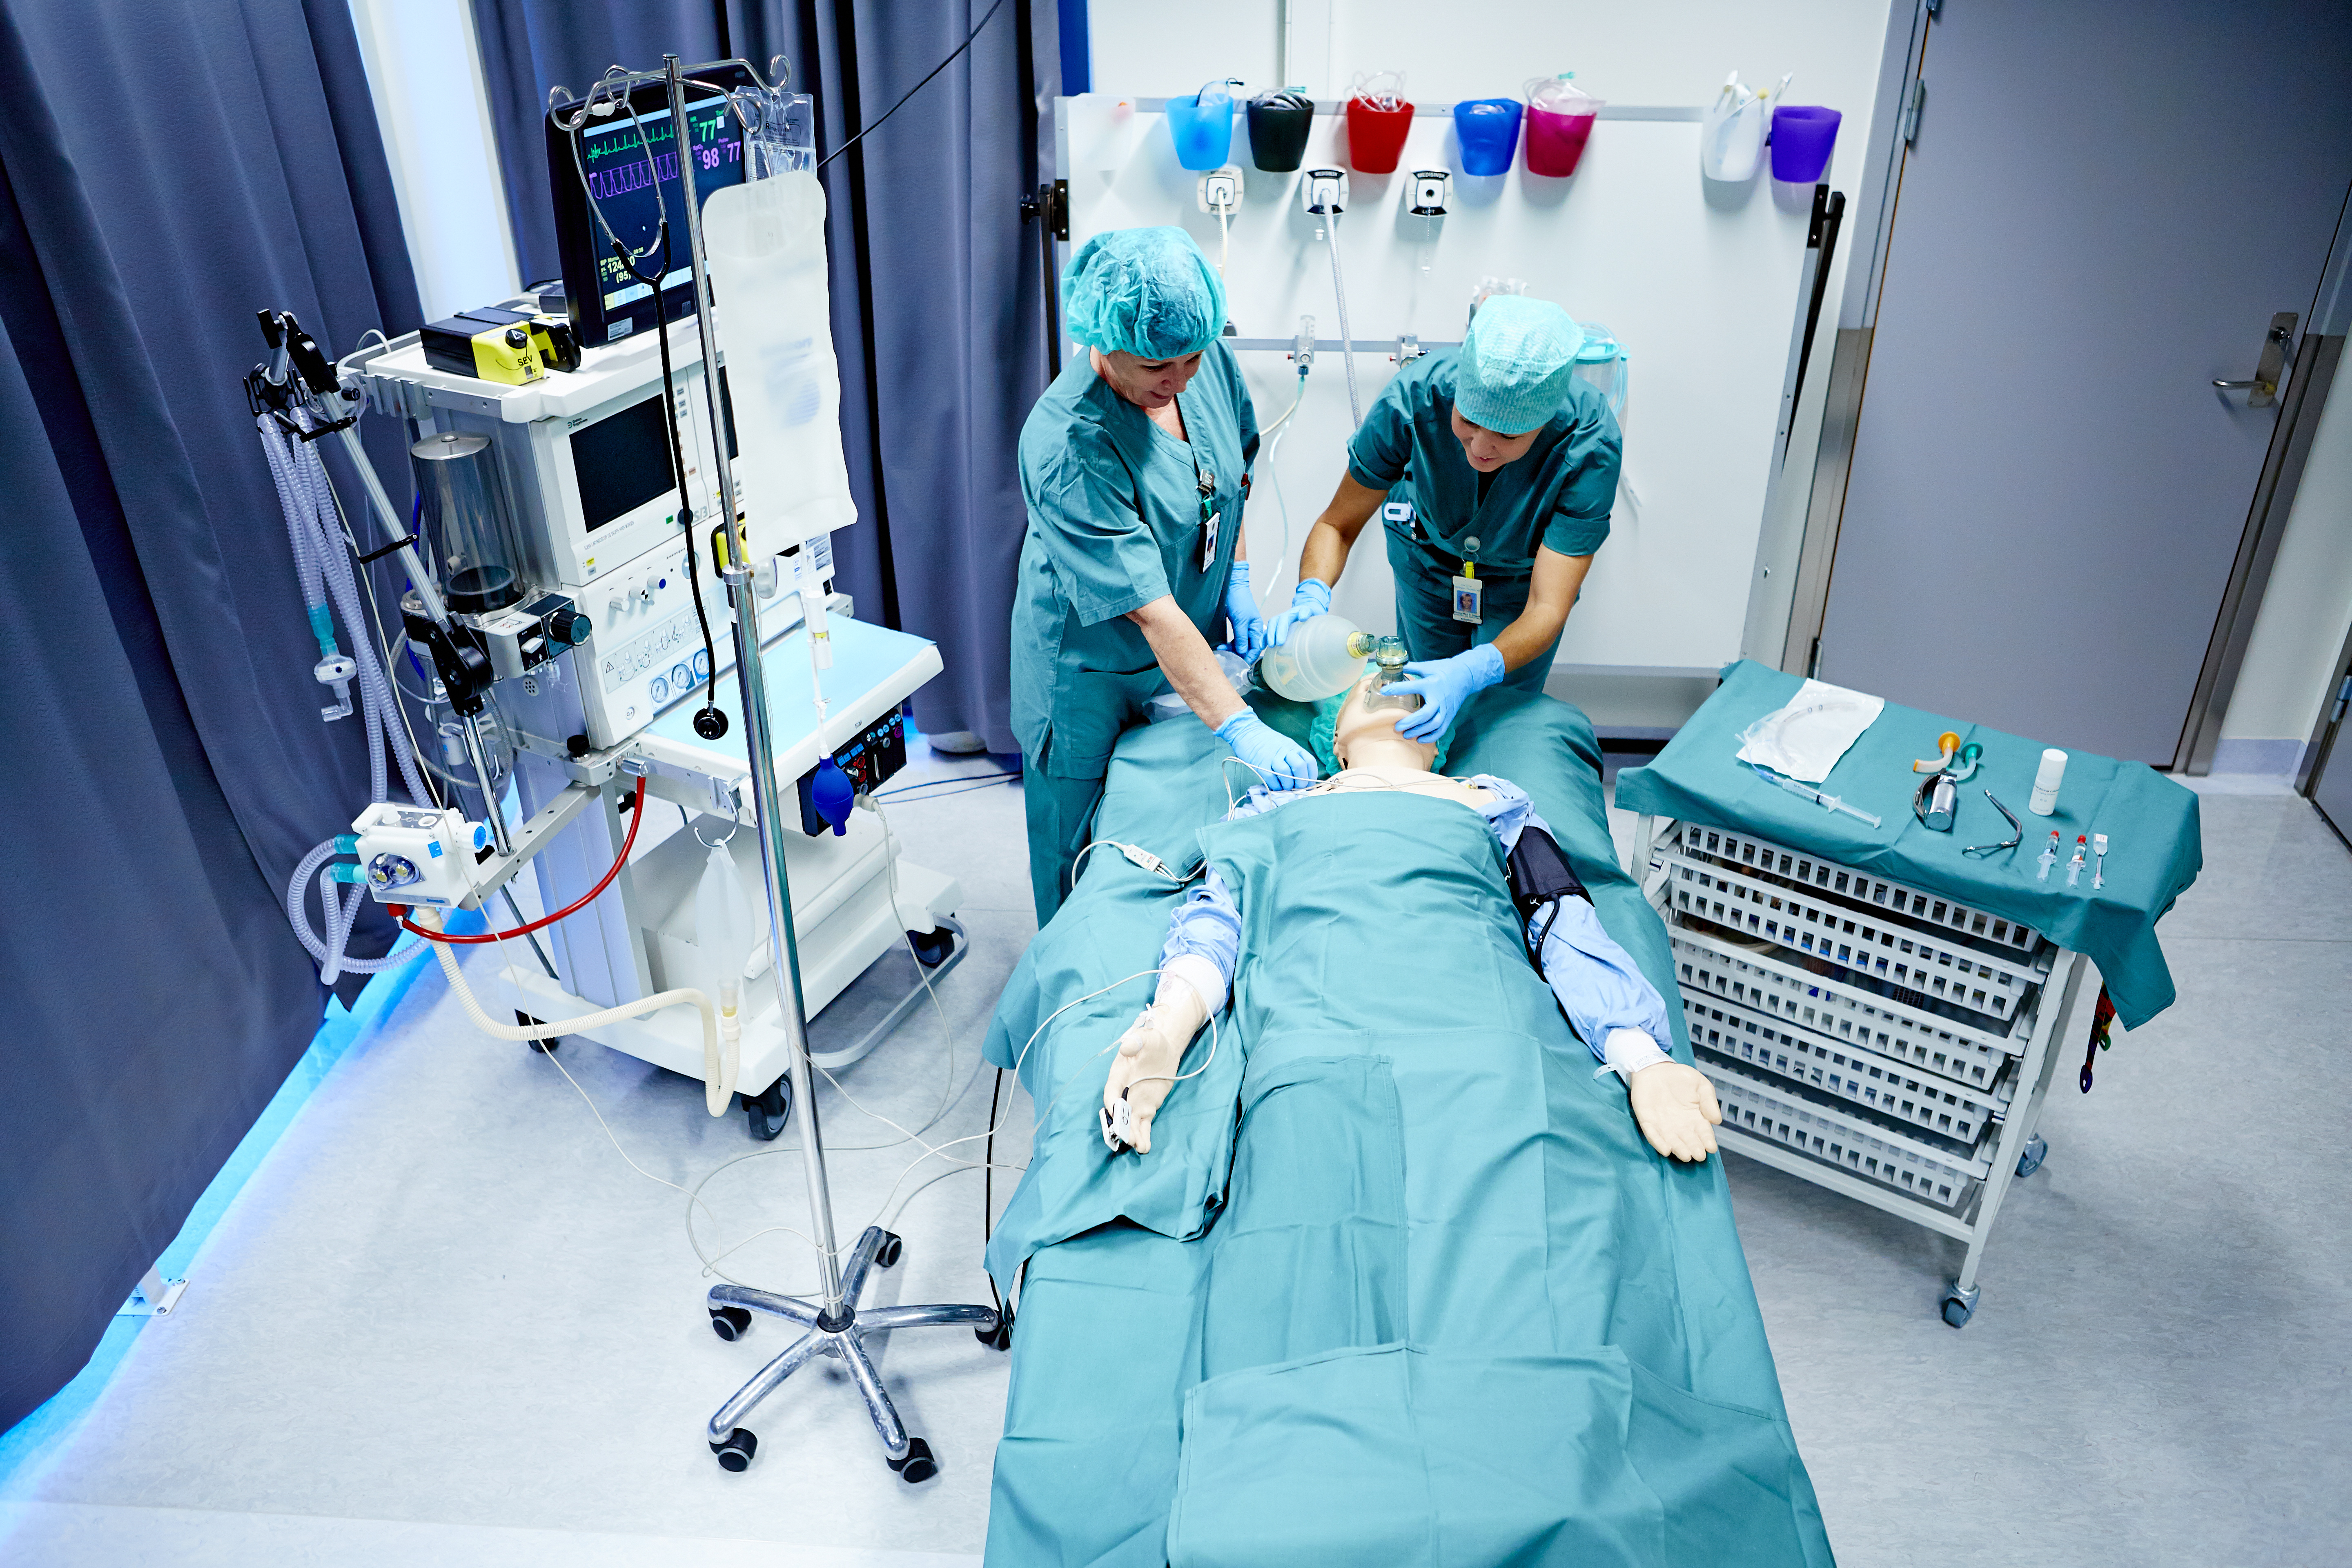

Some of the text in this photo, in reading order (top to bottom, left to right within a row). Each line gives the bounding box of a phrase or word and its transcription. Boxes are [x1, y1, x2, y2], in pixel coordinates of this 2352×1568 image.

[699, 119, 716, 142] 77
[702, 147, 719, 170] 98
[727, 140, 741, 163] 77
[517, 355, 532, 366] SEV
[692, 506, 708, 524] S/3
